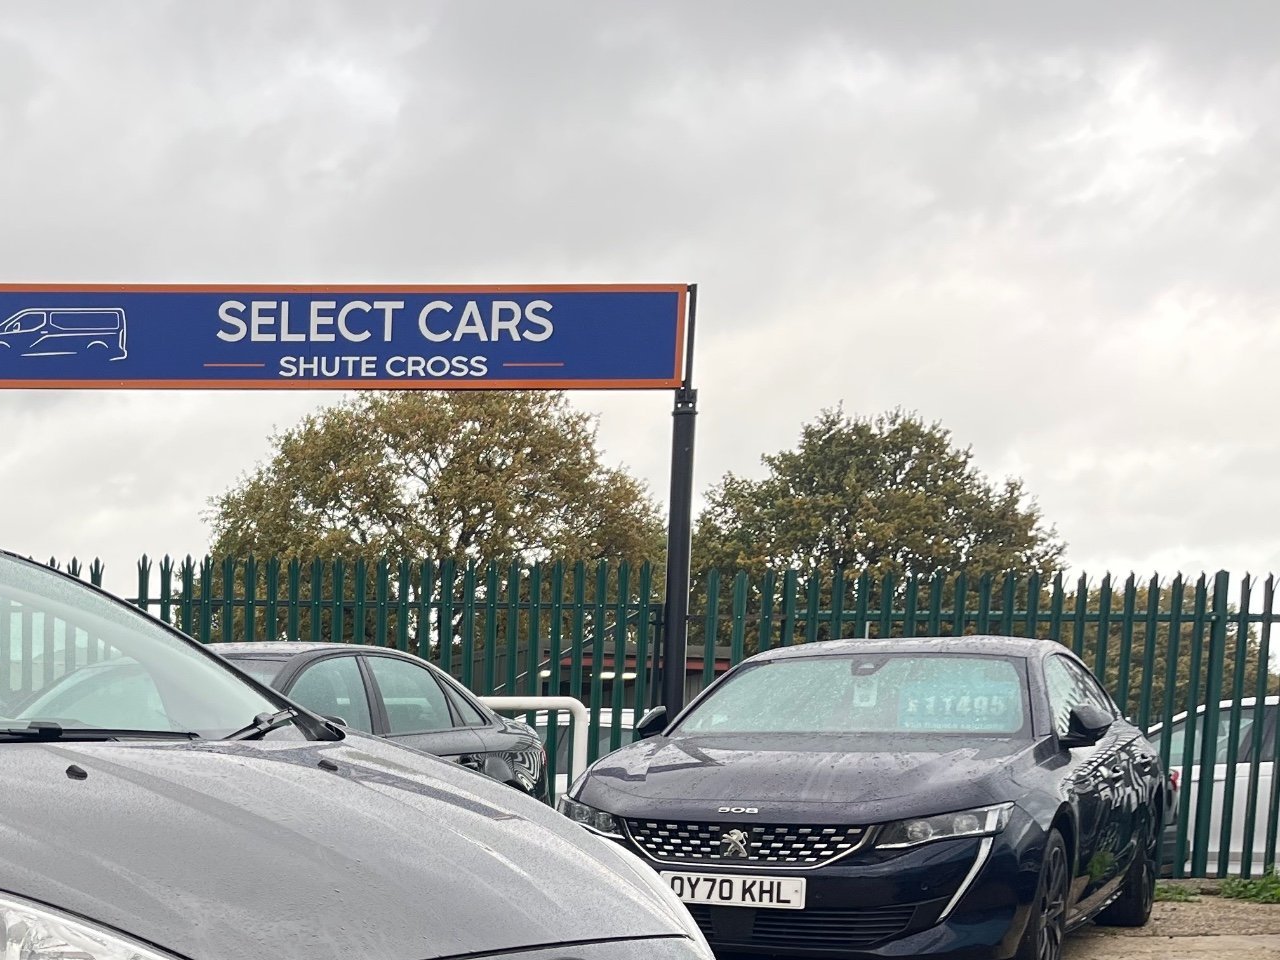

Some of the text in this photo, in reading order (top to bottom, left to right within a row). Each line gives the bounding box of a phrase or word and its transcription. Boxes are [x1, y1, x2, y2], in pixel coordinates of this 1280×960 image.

[216, 300, 554, 342] SELECT CARS
[278, 356, 488, 378] SHUTE CROSS
[671, 876, 791, 904] OY70 KHL
